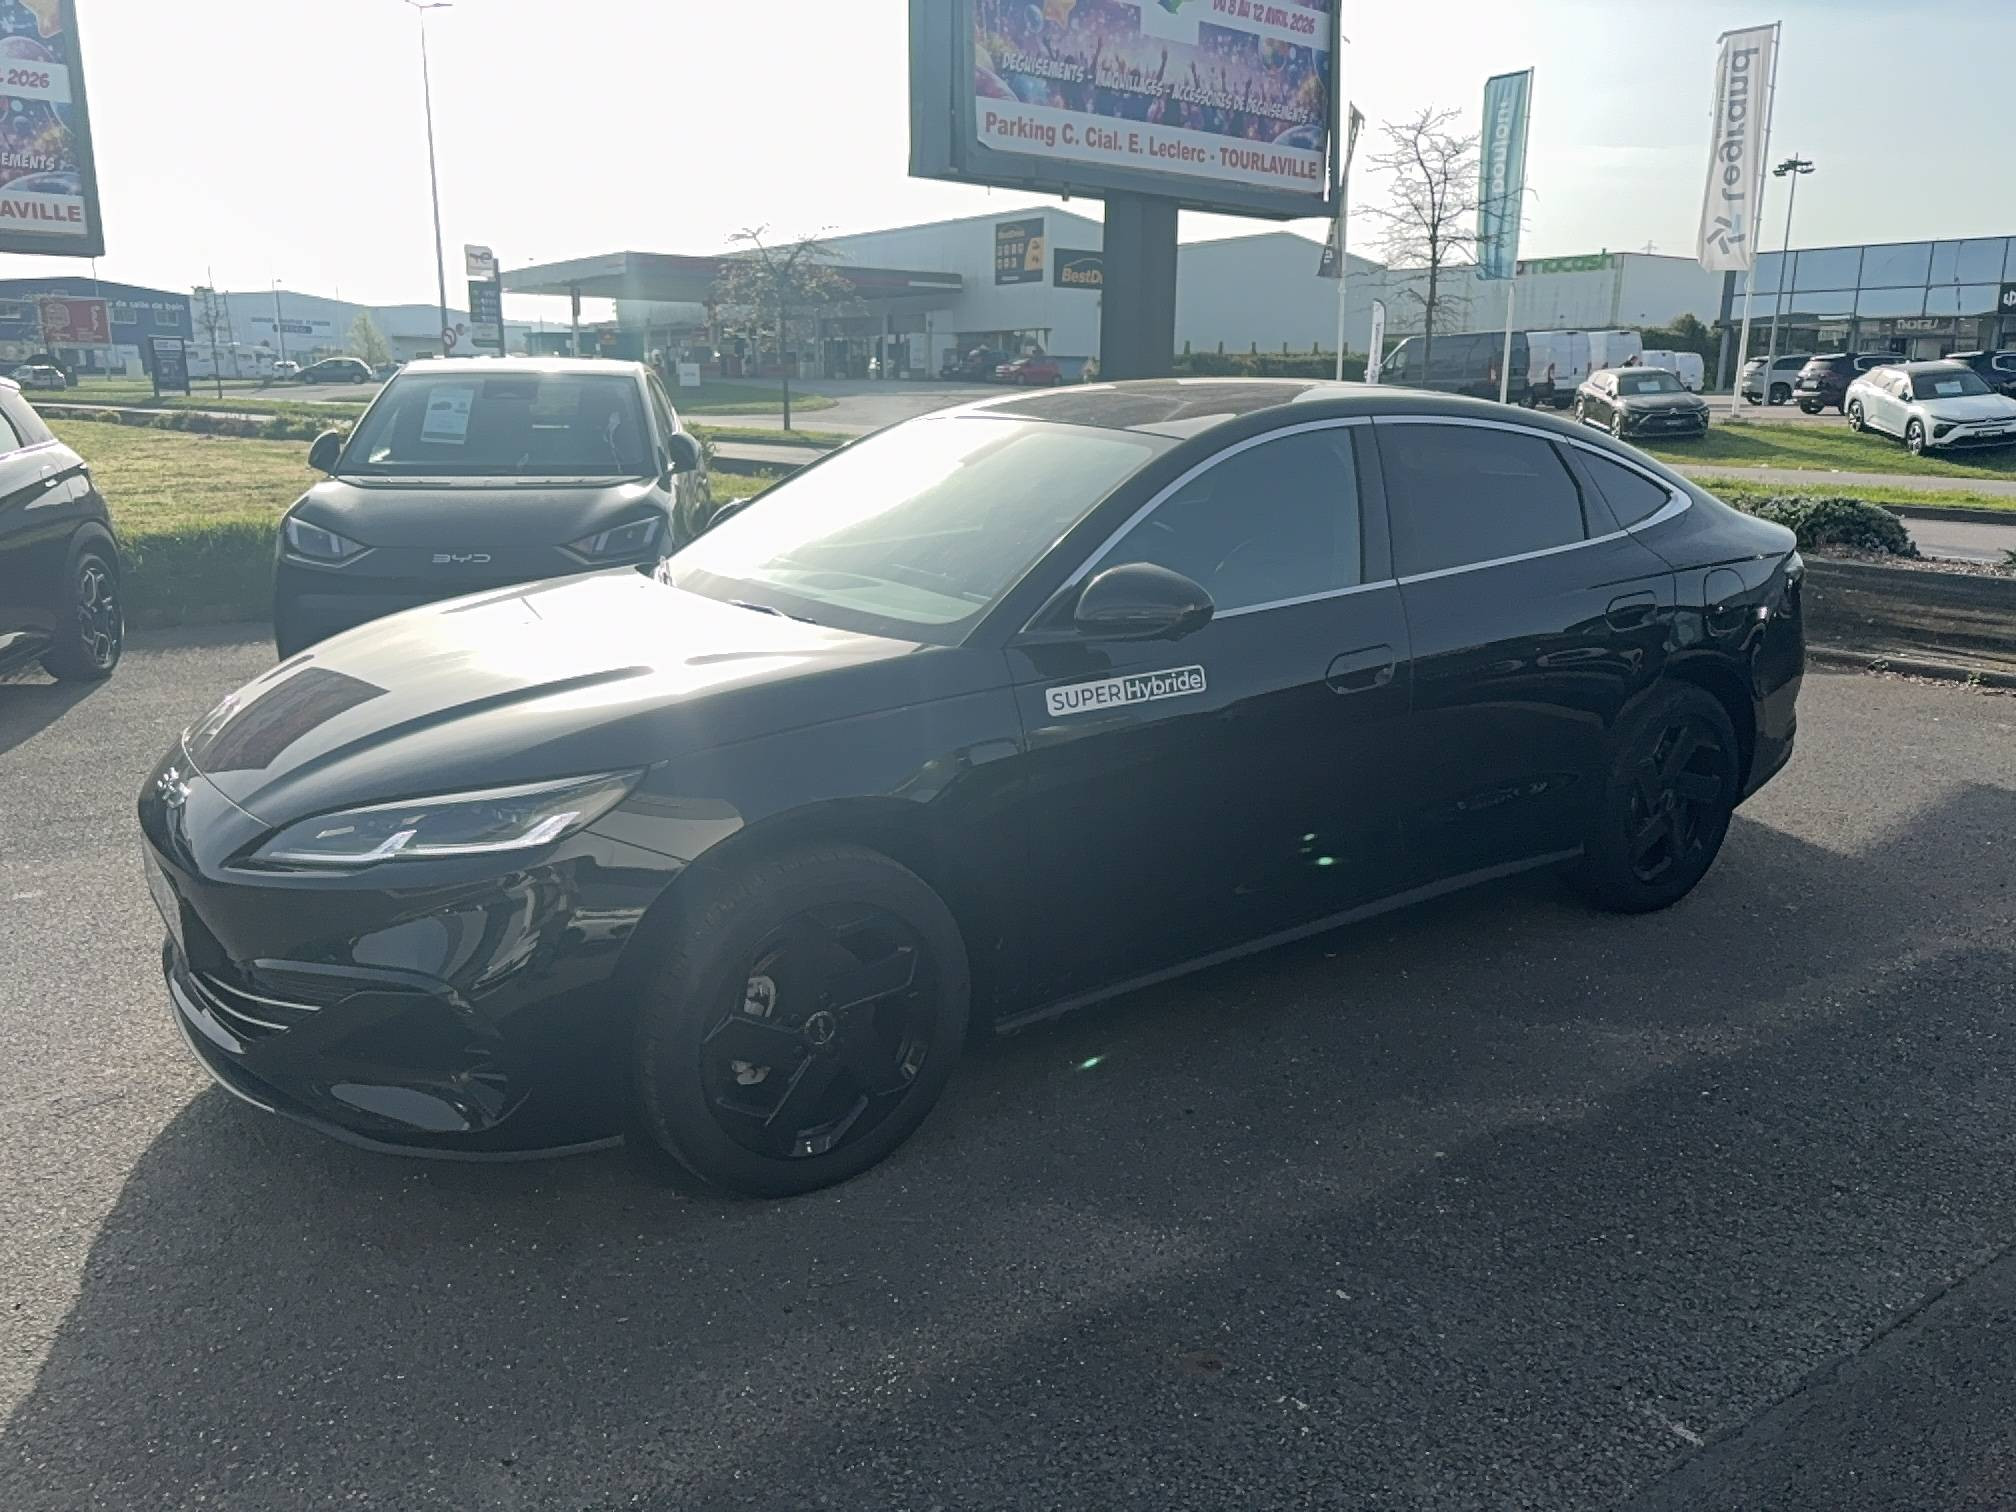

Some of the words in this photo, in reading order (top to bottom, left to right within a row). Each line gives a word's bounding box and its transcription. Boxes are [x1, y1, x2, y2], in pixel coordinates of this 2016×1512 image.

[1253, 3, 1265, 22] 12
[1264, 6, 1289, 28] AVRIL
[1290, 13, 1315, 34] 2026
[8, 68, 50, 89] 2026
[985, 111, 1056, 147] Parking
[1062, 123, 1080, 145] C.
[1085, 126, 1122, 151] Cial.
[1128, 133, 1143, 154] E.
[1149, 136, 1206, 163] Leclerc
[1219, 147, 1317, 180] TOURLAVILLE
[432, 553, 491, 563] BYD
[1053, 684, 1121, 711] SUPER
[1125, 671, 1201, 701] Hybride
